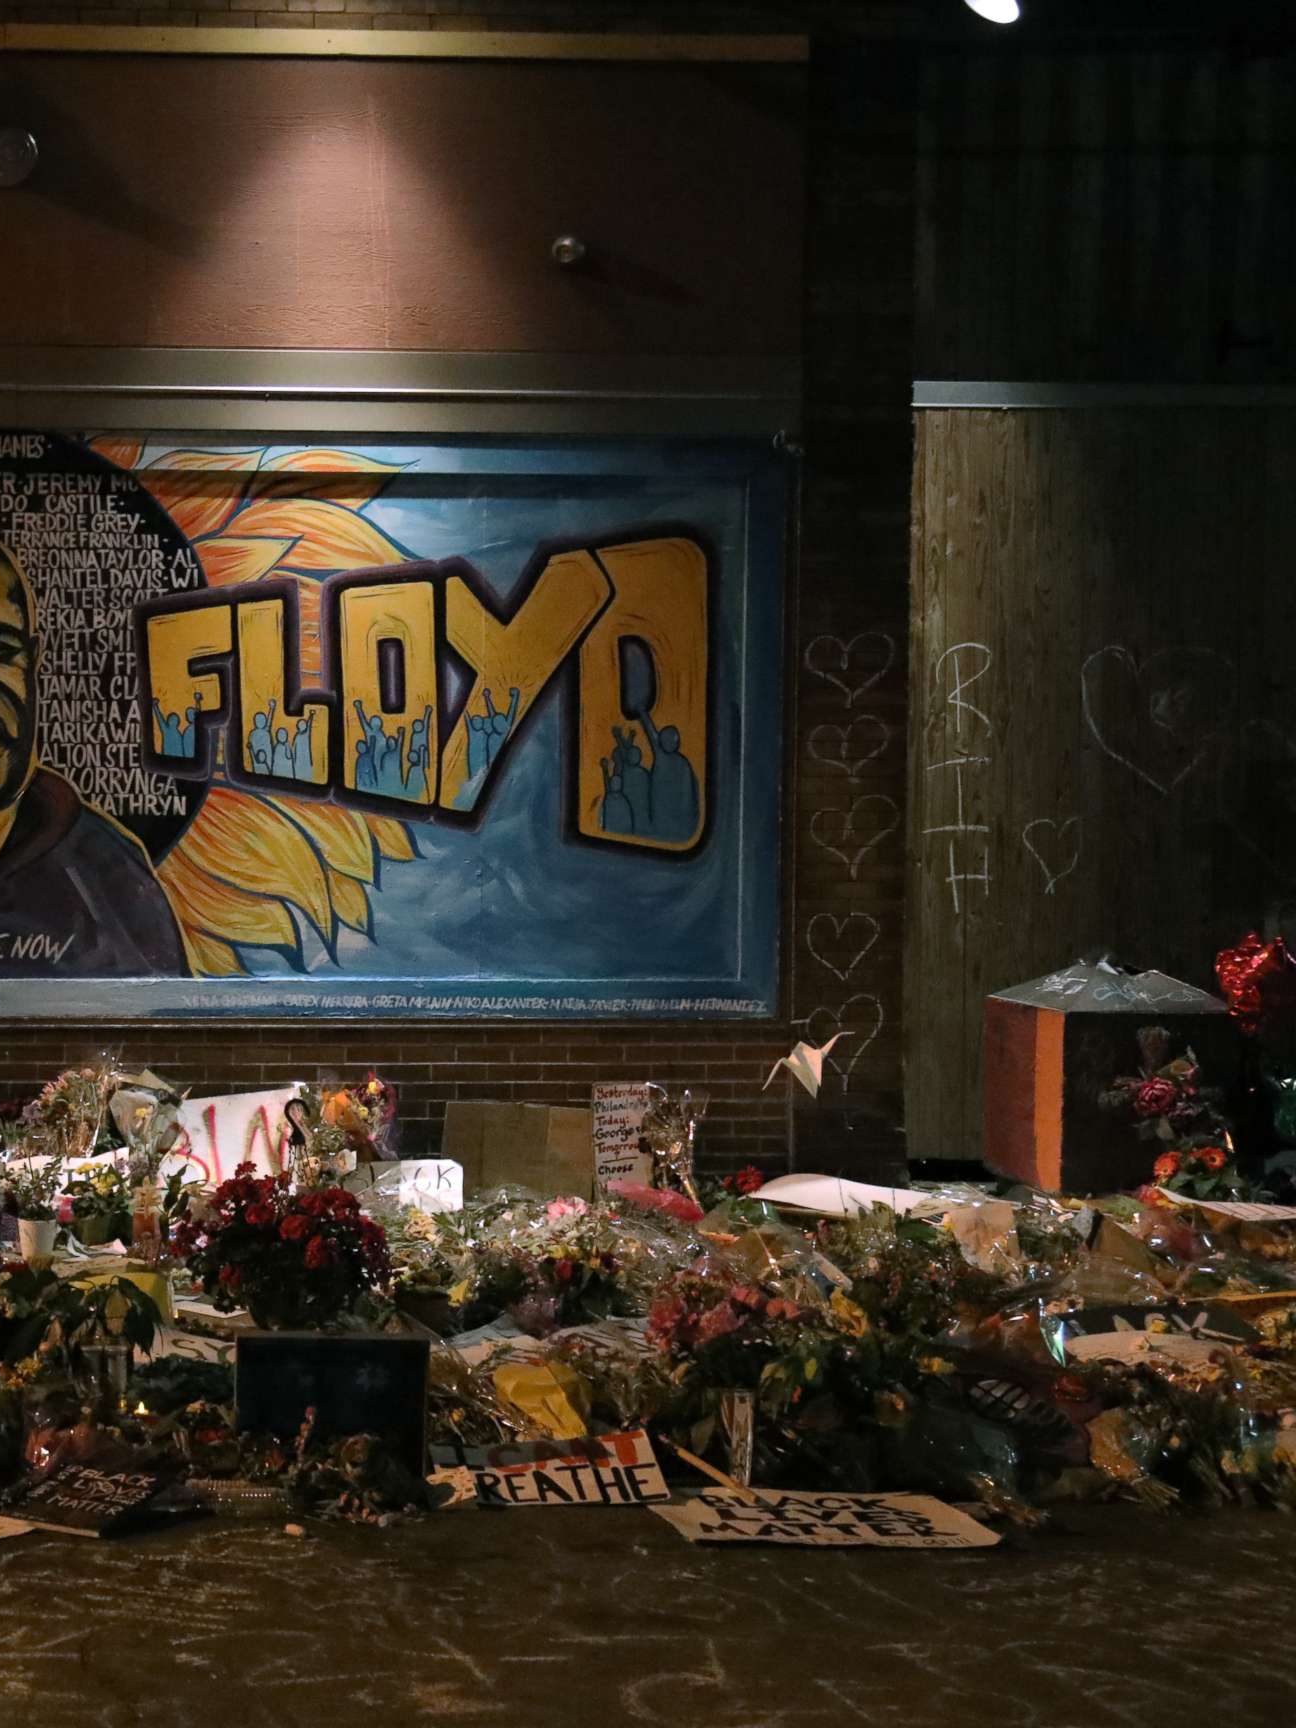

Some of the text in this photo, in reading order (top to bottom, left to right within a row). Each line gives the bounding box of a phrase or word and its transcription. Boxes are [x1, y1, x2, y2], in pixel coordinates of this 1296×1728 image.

[23, 473, 102, 495] JEREMY
[45, 494, 118, 515] CASTILE
[12, 511, 87, 532] FREDDIE
[91, 513, 139, 533] GREY
[4, 530, 77, 549] TERRANCE
[79, 532, 159, 550] FRANKLIN
[17, 548, 98, 569] BREONNA
[98, 549, 166, 569] TAYLOR
[172, 548, 198, 569] AL
[26, 568, 109, 589] SHANTEL
[110, 569, 163, 589] DAVIS
[171, 569, 199, 589] WI
[32, 587, 105, 610] WALTER
[36, 607, 87, 630] REKIA
[39, 652, 109, 676] SHELLY
[39, 675, 105, 701] JAMAR
[145, 537, 709, 853] FLOYD
[39, 700, 122, 724] TANISHA
[39, 722, 109, 745] TARIKA
[40, 743, 140, 768] ALTON STE
[90, 793, 187, 817] KATHRYN
[10, 933, 76, 965] NOW
[475, 1462, 668, 1504] REATHE
